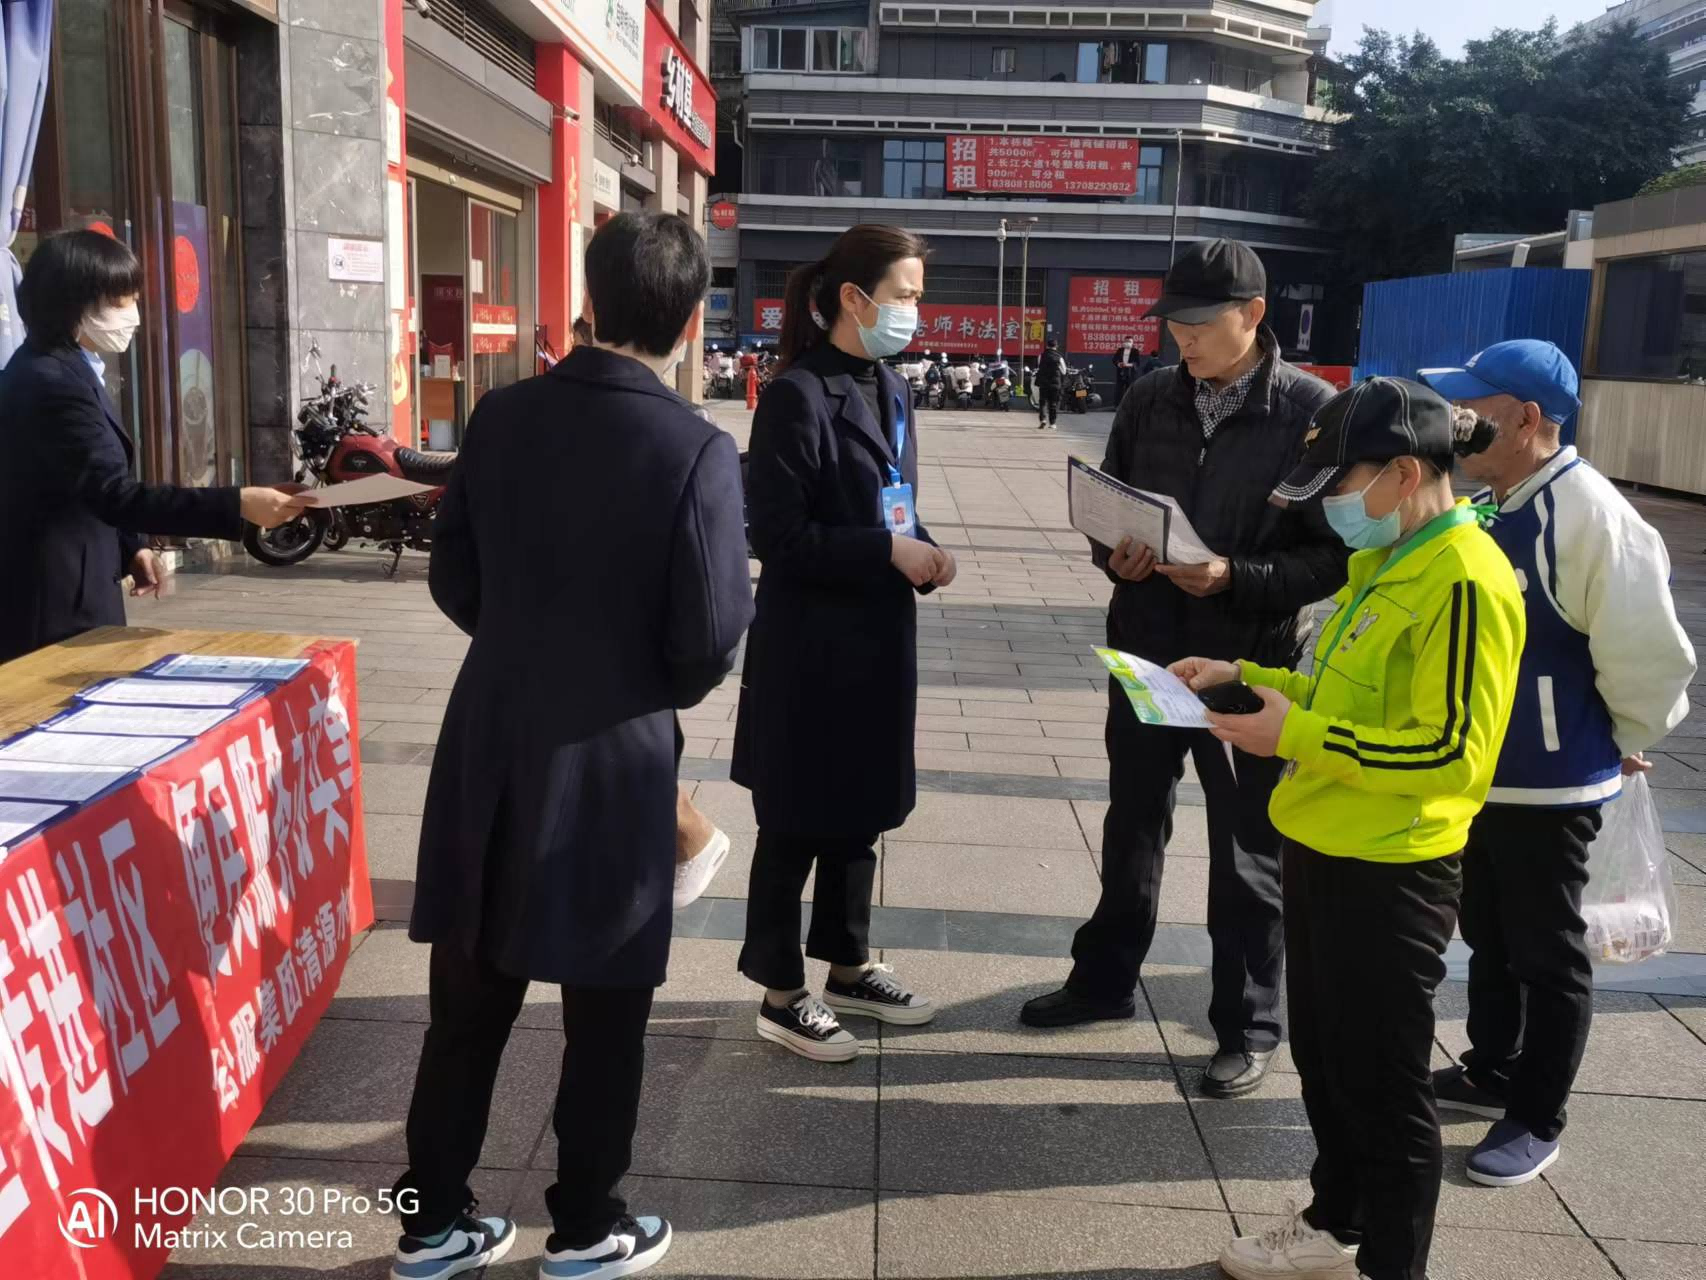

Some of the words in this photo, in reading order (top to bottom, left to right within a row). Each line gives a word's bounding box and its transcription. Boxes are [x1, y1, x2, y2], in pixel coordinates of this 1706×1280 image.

[952, 138, 977, 188] 招租
[1093, 279, 1140, 296] 招租
[761, 307, 783, 329] 爱
[1082, 333, 1145, 341] 1838081806
[1084, 342, 1145, 352] 137082932
